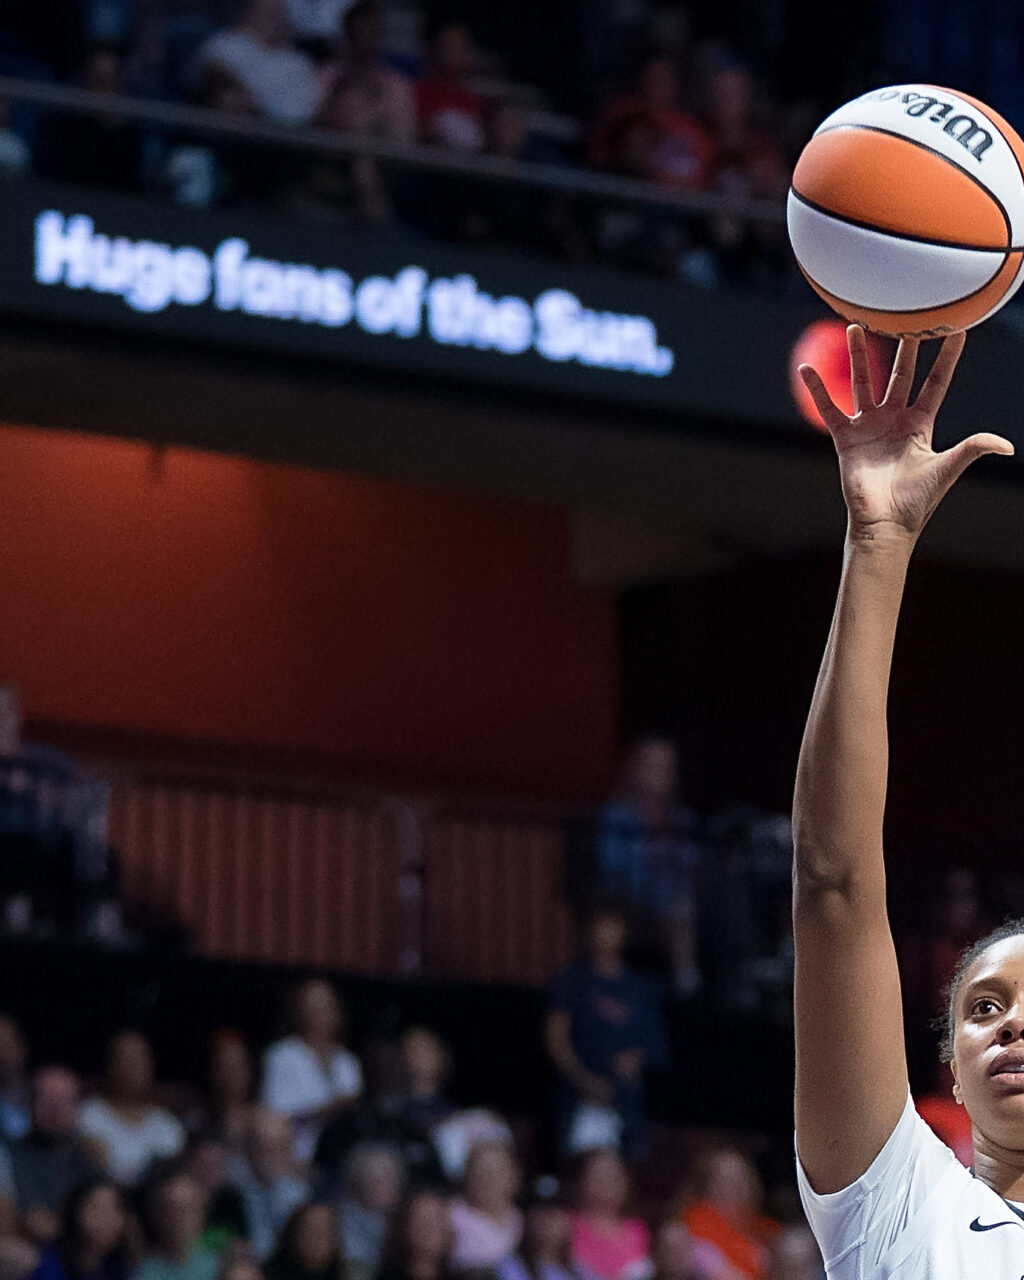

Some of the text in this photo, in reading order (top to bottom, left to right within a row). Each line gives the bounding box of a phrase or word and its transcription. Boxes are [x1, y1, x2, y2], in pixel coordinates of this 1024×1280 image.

[868, 90, 993, 162] Wilso
[35, 210, 673, 376] Huge fans of the Sun.
